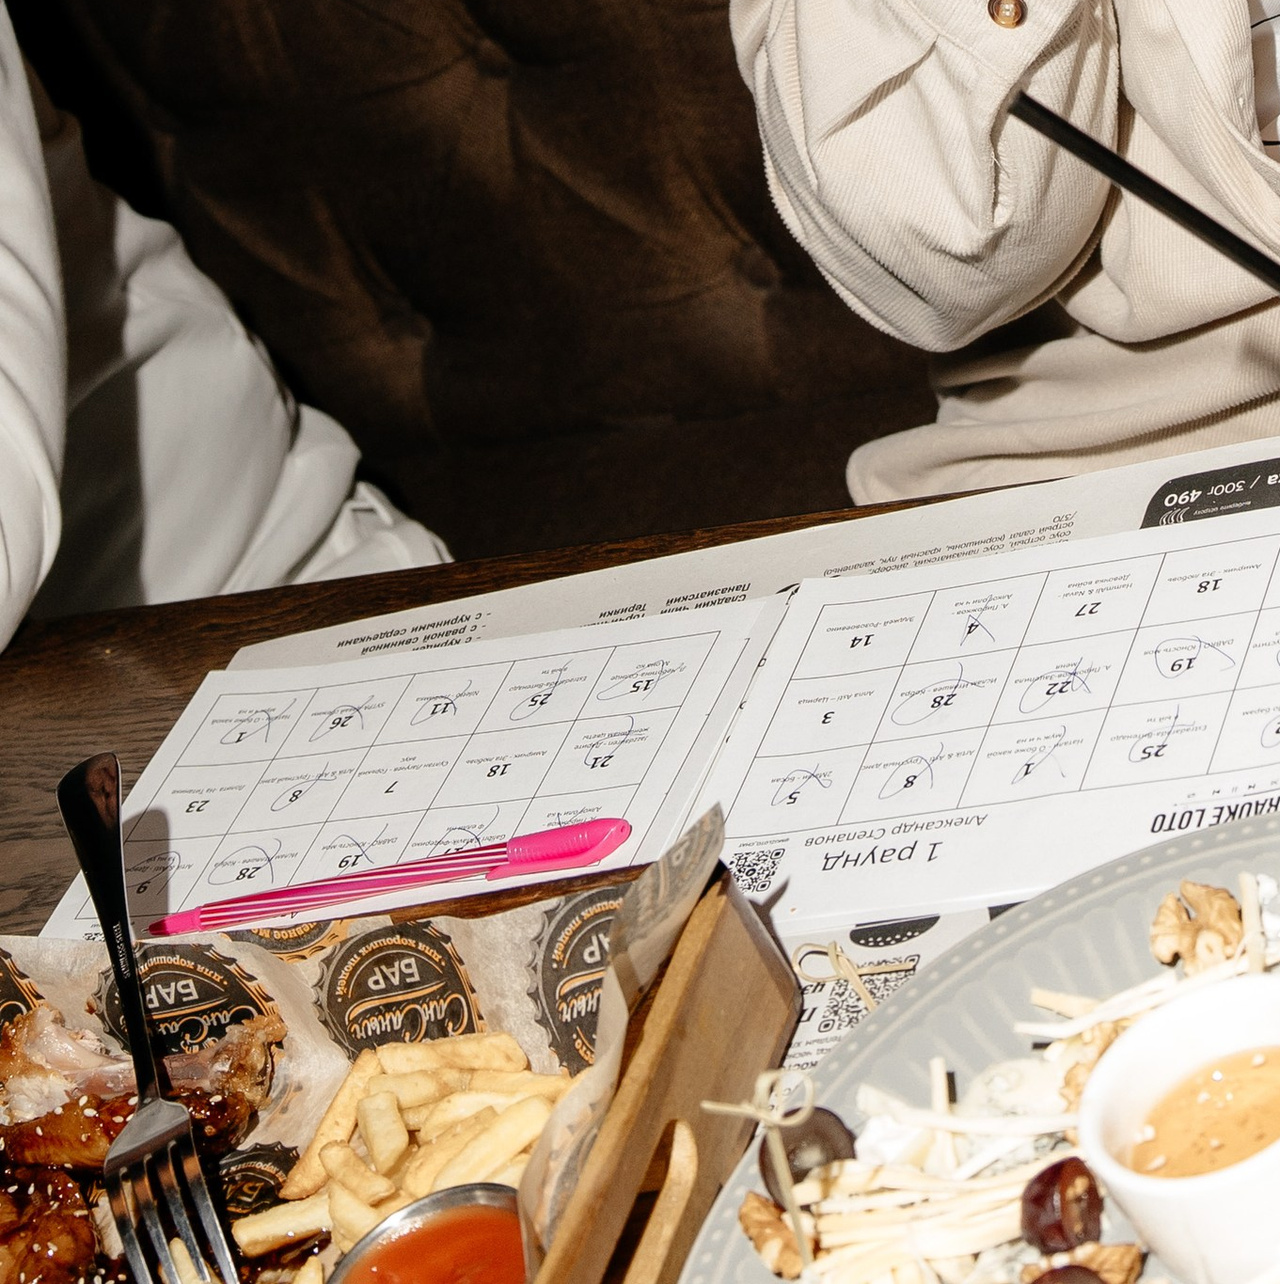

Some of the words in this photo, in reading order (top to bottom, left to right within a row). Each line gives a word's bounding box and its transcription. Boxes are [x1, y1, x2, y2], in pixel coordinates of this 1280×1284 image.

[1207, 480, 1246, 496] 300г
[1164, 489, 1203, 507] 490
[1010, 528, 1036, 539] салат
[1039, 521, 1074, 534] острый
[1049, 530, 1072, 540] соус
[945, 533, 1006, 551] (корнишоны,
[982, 541, 1004, 552] соус
[880, 553, 897, 564] лук,
[900, 545, 942, 561] красный
[912, 547, 979, 568] паназиатский,
[824, 557, 877, 577] халапеньо)
[1197, 577, 1223, 593] 18
[666, 583, 752, 606] Паназиатский
[599, 602, 647, 619] Терияки
[1075, 601, 1102, 617] 27
[410, 614, 471, 634] куриными
[967, 622, 980, 635] 4
[336, 628, 407, 648] сердечками
[423, 625, 467, 642] рваной
[361, 636, 419, 656] свининой
[849, 634, 875, 649] 14
[1170, 657, 1196, 672] 19
[629, 678, 654, 693] 15
[1045, 681, 1072, 696] 22
[527, 692, 552, 707] 25
[930, 693, 957, 708] 28
[429, 702, 451, 715] 11
[329, 715, 354, 730] 26
[822, 712, 835, 724] 3
[235, 732, 247, 743] 1
[1140, 744, 1168, 760] 25
[590, 755, 614, 769] 21
[1023, 762, 1035, 777] 1
[487, 763, 512, 778] 18
[384, 781, 398, 793] 7
[903, 775, 917, 789] 8
[289, 790, 303, 803] 8
[786, 791, 801, 805] 5
[185, 800, 210, 813] 23
[891, 814, 988, 838] Александр
[1150, 807, 1206, 835] LOTO
[804, 826, 887, 848] Степанов
[819, 841, 919, 872] раунд
[928, 841, 944, 862] 1
[338, 854, 363, 869] 19
[236, 865, 261, 880] 28
[136, 881, 151, 894] 9
[358, 935, 416, 957] хороших
[367, 957, 421, 990] БАР
